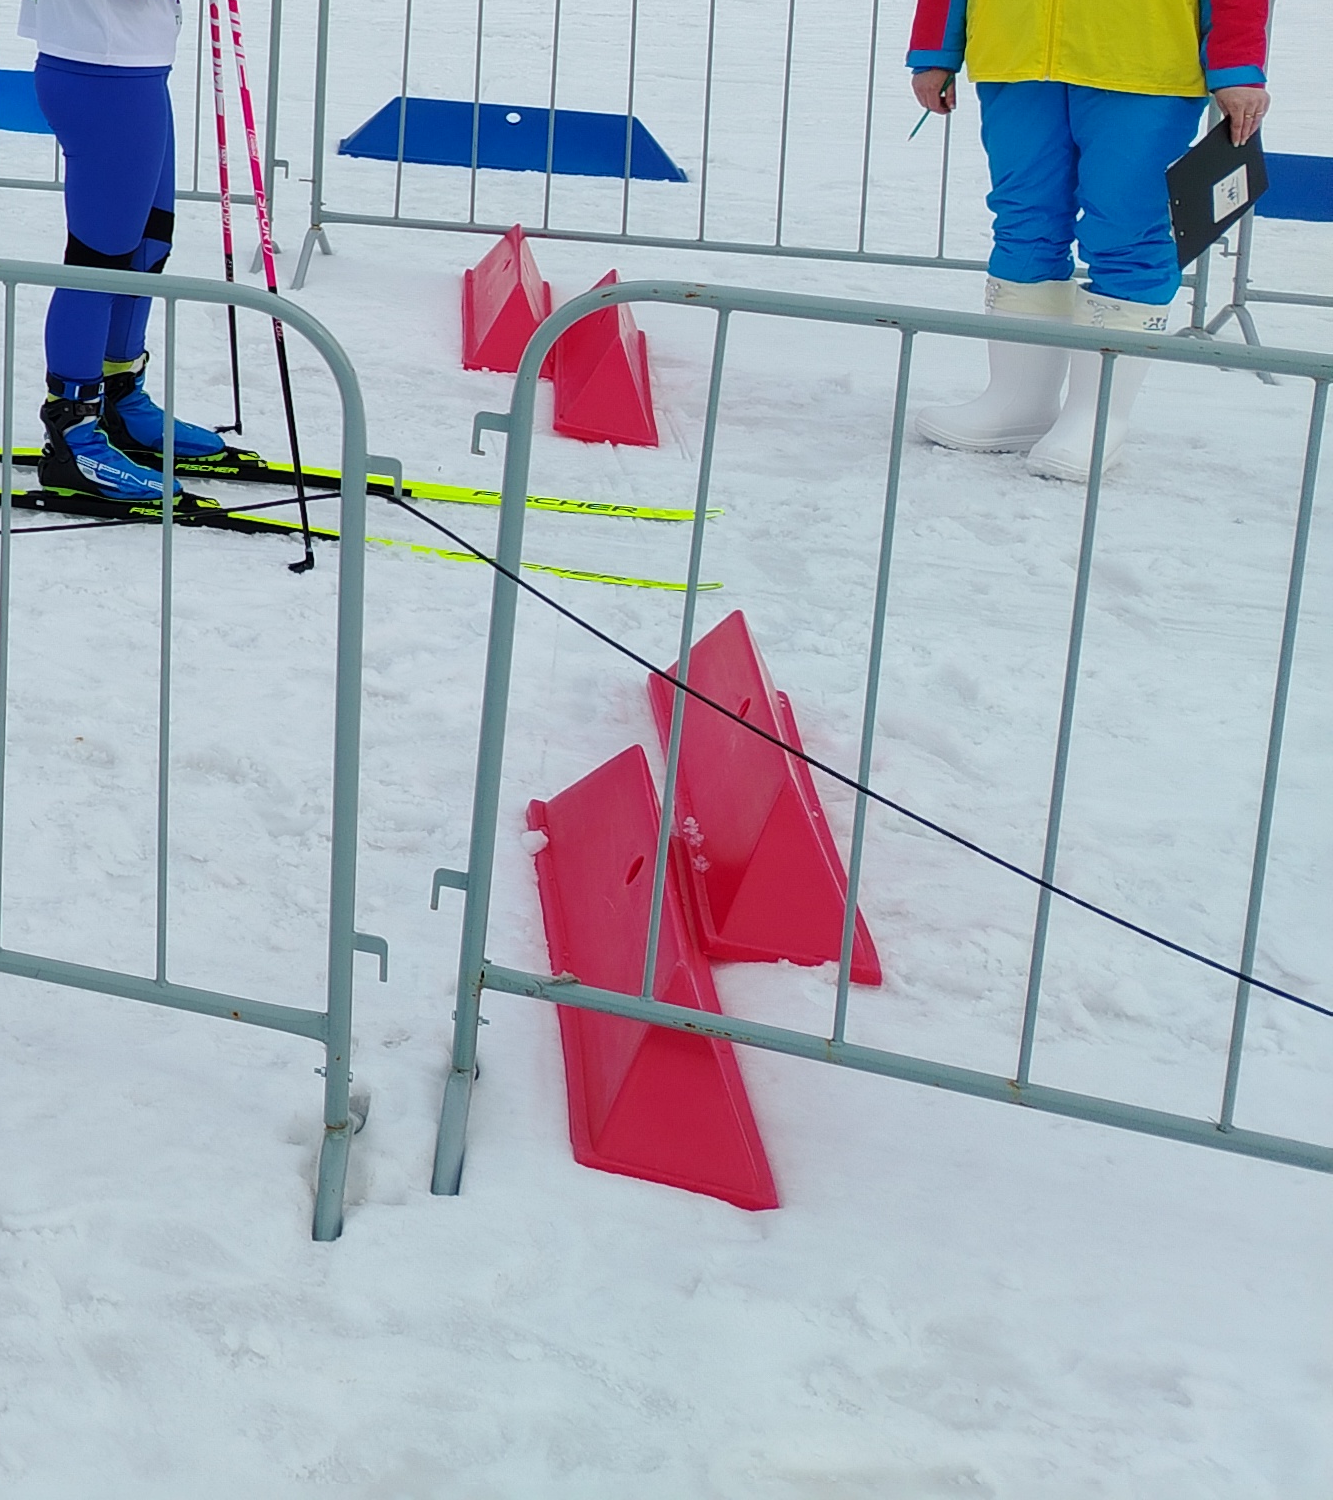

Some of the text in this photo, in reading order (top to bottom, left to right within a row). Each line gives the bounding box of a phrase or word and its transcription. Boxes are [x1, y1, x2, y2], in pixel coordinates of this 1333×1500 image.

[76, 454, 165, 492] SPINE
[175, 462, 240, 475] FISCHER
[472, 490, 638, 514] FCHER
